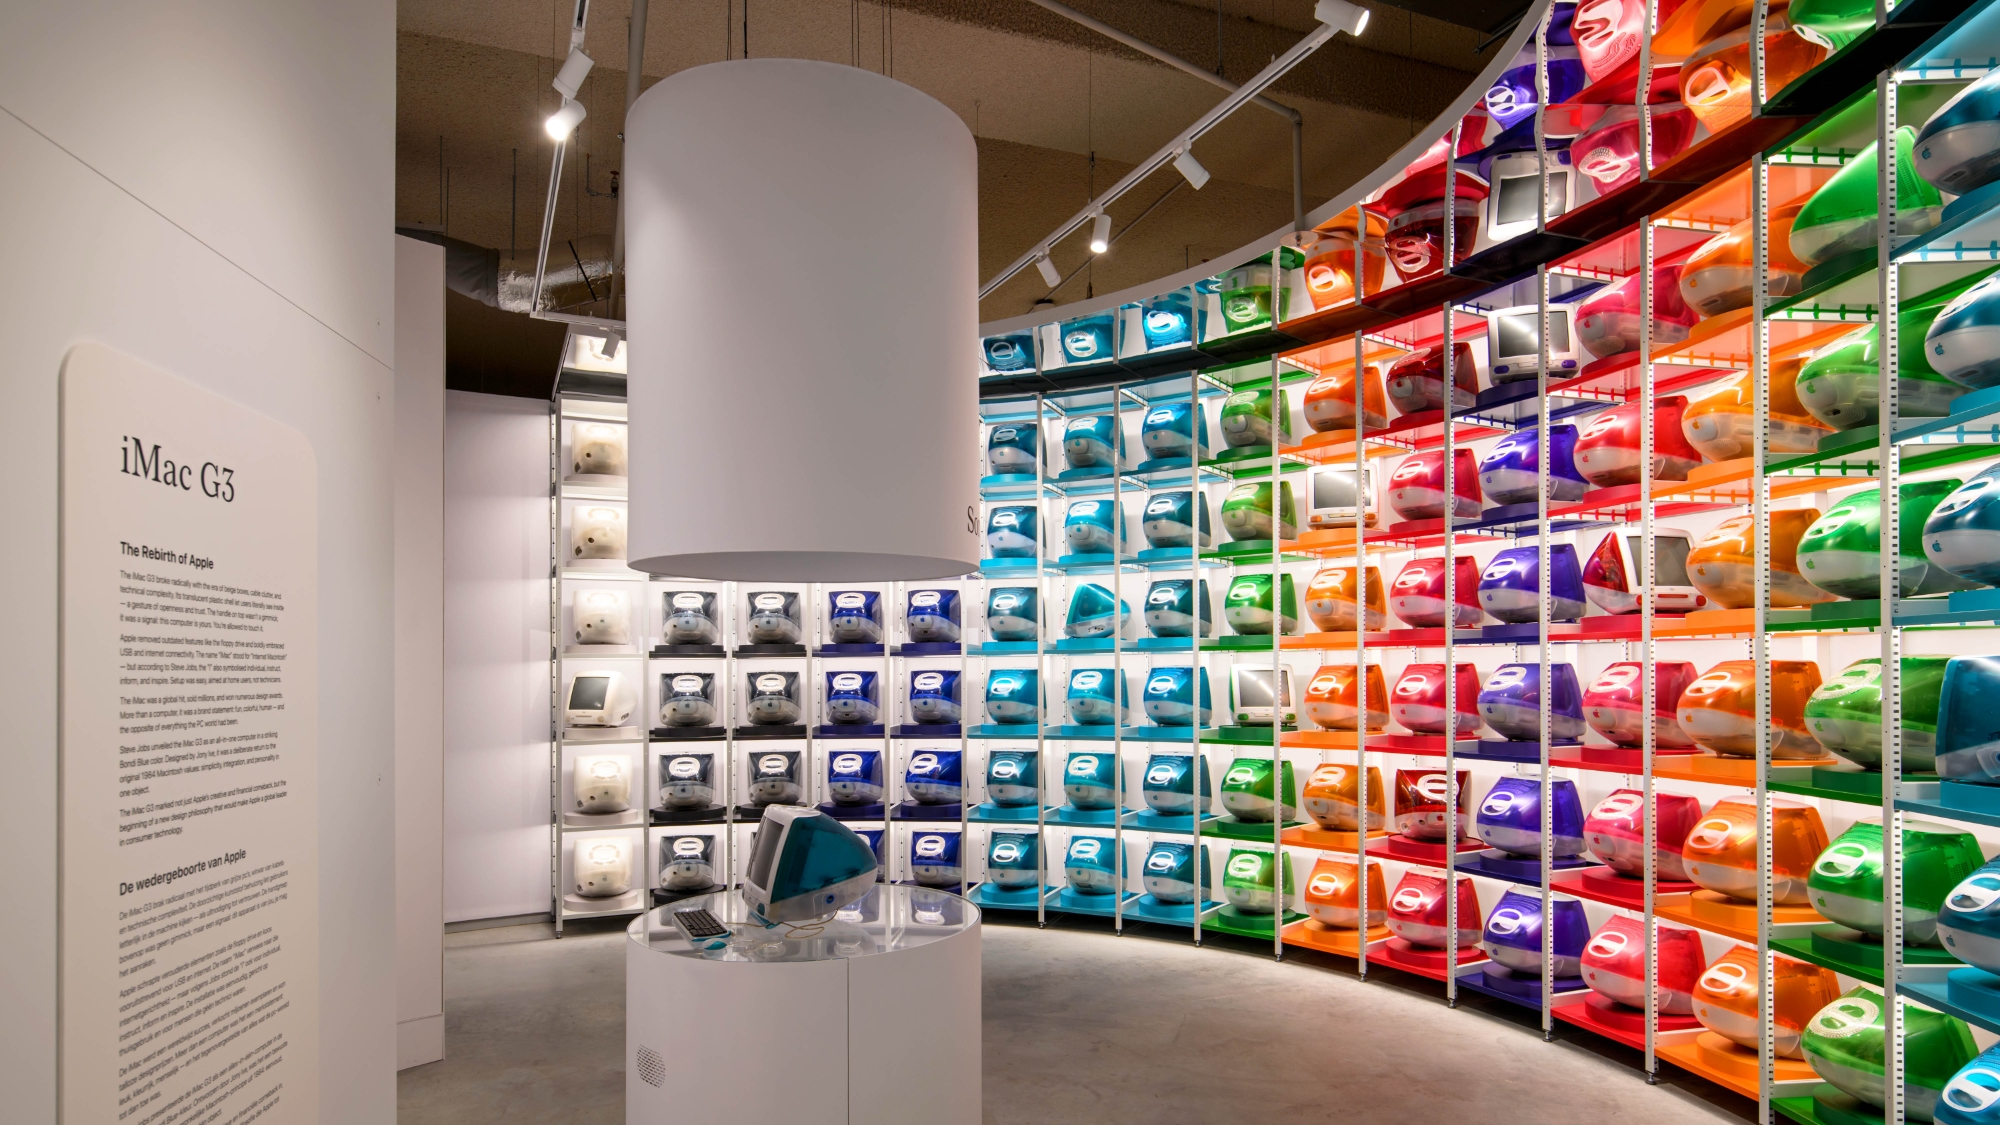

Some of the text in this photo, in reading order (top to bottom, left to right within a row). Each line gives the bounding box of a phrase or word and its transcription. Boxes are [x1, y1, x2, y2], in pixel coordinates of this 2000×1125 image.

[121, 436, 235, 502] iMac G3
[967, 505, 980, 537] So
[120, 541, 214, 570] The Rebirth of Apple
[120, 570, 132, 580] The
[132, 572, 146, 582] iMac
[146, 574, 155, 583] G3
[156, 576, 171, 585] broke
[171, 579, 192, 589] radically
[224, 586, 237, 594] beige
[120, 586, 145, 595] technical
[146, 590, 175, 600] complexity.
[182, 593, 209, 602] translucent
[251, 601, 265, 610] literally
[131, 602, 153, 610] gesture
[159, 605, 184, 613] openness
[207, 608, 217, 616] The
[216, 610, 232, 618] handle
[159, 617, 170, 625] this
[169, 619, 194, 627] computer
[120, 634, 137, 643] Apple
[137, 636, 162, 644] removed
[161, 637, 185, 645] outdated
[184, 637, 204, 646] features
[204, 638, 212, 646] like
[221, 639, 234, 648] floppy
[253, 641, 266, 649] boldly
[120, 648, 133, 657] USB
[165, 651, 195, 659] connectivity.
[127, 663, 137, 671] but
[137, 663, 164, 672] according
[170, 663, 185, 671] Steve
[140, 677, 151, 685] and
[170, 677, 185, 685] Setup
[120, 697, 132, 705] The
[162, 696, 178, 705] global
[120, 711, 135, 719] More
[197, 707, 212, 715] brand
[119, 726, 130, 734] the
[130, 724, 154, 734] opposite
[161, 722, 188, 731] everything
[197, 720, 204, 728] PC
[120, 746, 136, 754] Steve
[137, 744, 151, 753] Jobs
[151, 742, 174, 751] unveiled
[195, 738, 203, 746] G3
[236, 734, 257, 742] computer
[120, 759, 136, 769] Bondi
[137, 758, 150, 767] Blue
[165, 753, 189, 763] Designed
[188, 753, 196, 761] by
[233, 746, 254, 754] deliberate
[119, 754, 275, 784] original 1984 Macintosh personality
[119, 790, 131, 798] one
[119, 786, 253, 817] The iMac G3 marked not just creative financial
[119, 821, 148, 833] beginning
[171, 812, 188, 821] design
[188, 807, 214, 819] philosophy
[214, 804, 224, 812] that
[224, 801, 237, 810] would
[249, 797, 261, 805] Apple
[263, 793, 276, 802] global
[125, 833, 154, 845] consumer
[120, 849, 246, 896] De wedergeboorte van Apple
[153, 881, 221, 909] brak radicaal tijdperk
[127, 917, 158, 932] technische
[196, 893, 225, 907] doorzichtige
[156, 902, 232, 935] machine kijken uitnodiging
[119, 949, 144, 964] bovenop
[119, 986, 137, 998] Apple
[137, 976, 161, 991] schrapte
